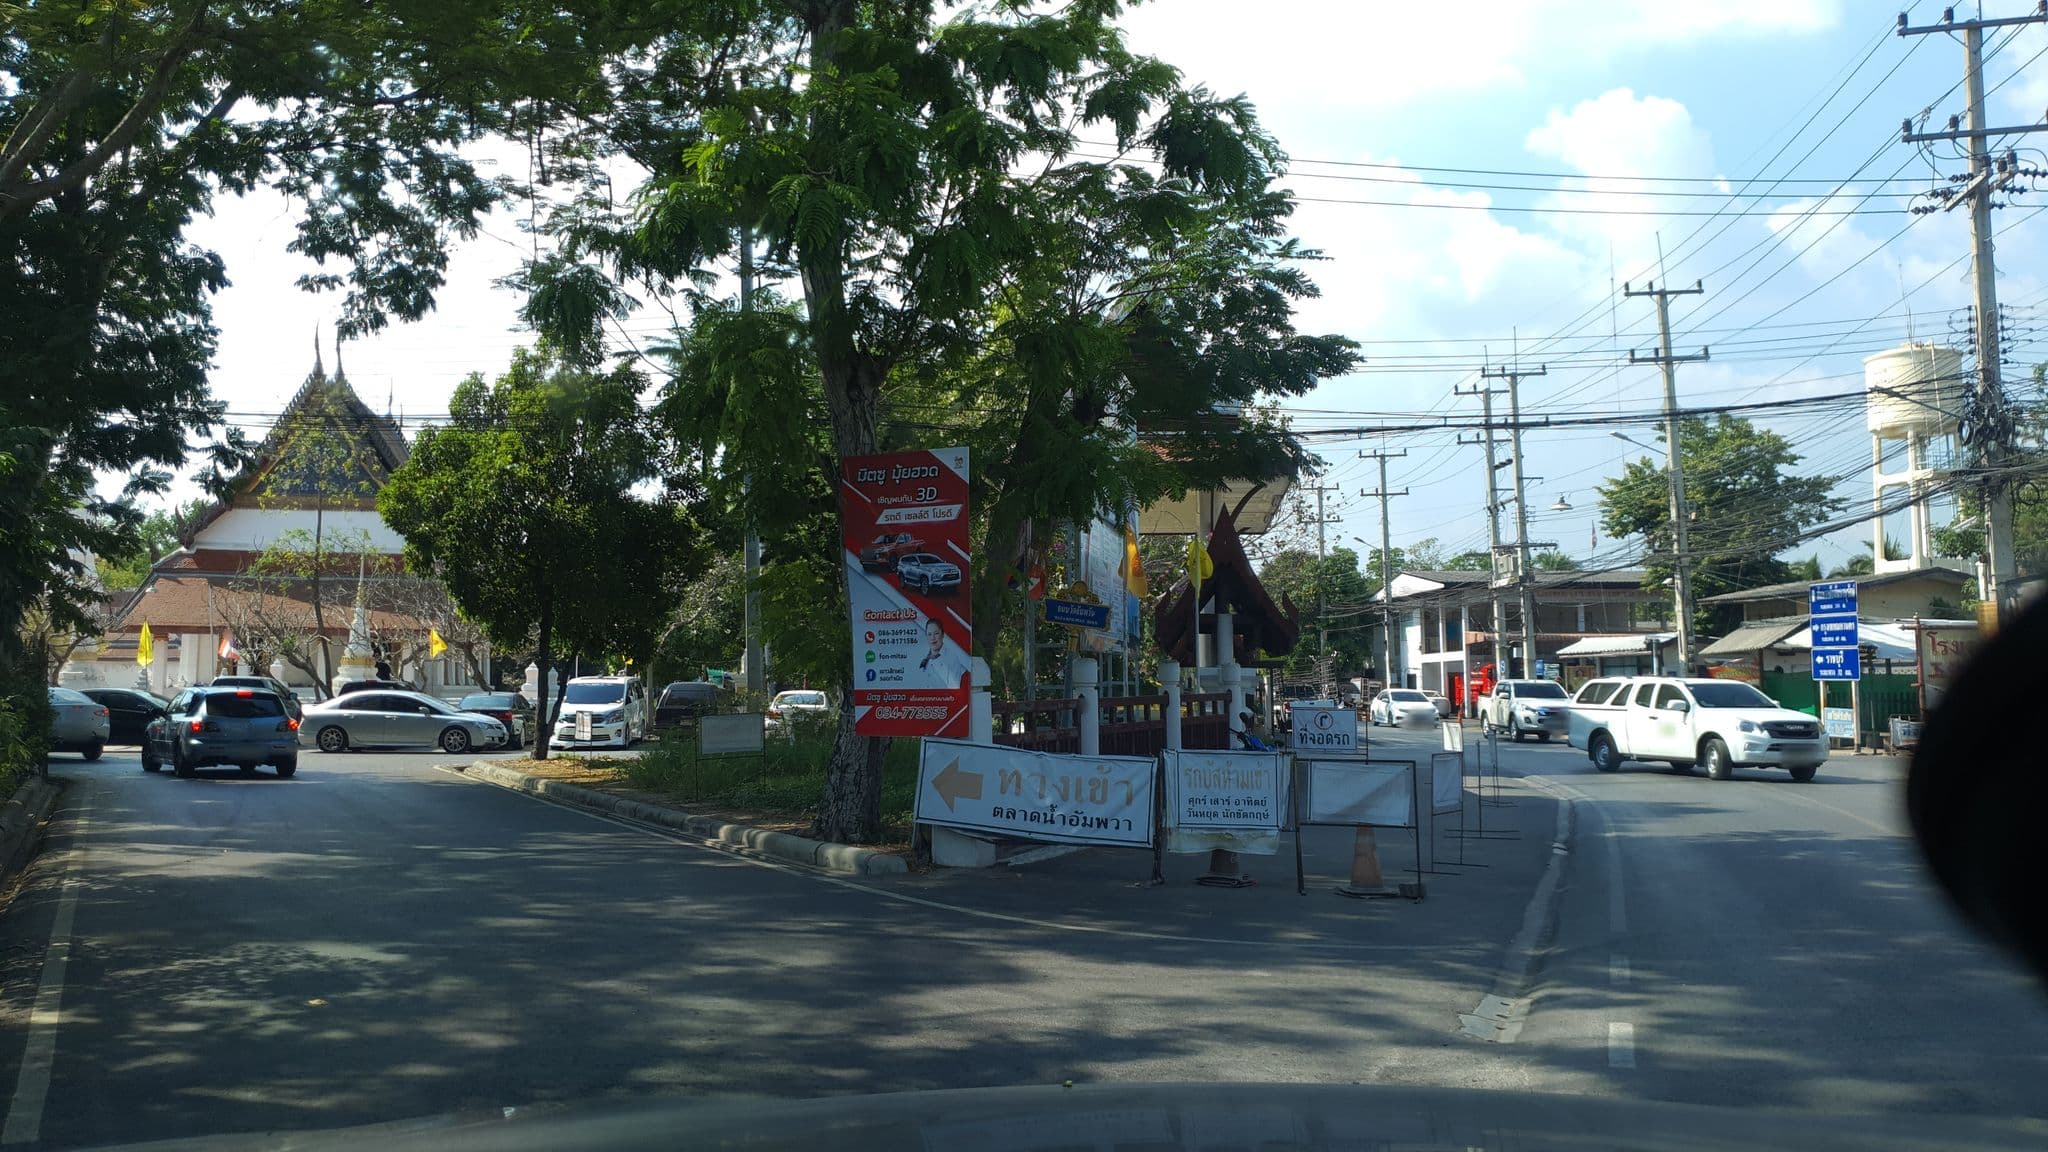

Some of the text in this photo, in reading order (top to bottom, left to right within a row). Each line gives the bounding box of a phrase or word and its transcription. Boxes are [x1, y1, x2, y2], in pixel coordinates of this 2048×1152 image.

[857, 467, 886, 485] มิตซู
[915, 487, 937, 501] 3D
[864, 608, 917, 620] Contact Us
[1826, 650, 1844, 668] ราชบุรี
[1299, 723, 1350, 745] ที่จอดรถ
[1188, 795, 1267, 807] ศุกร์ เสาร์ อาทิตย์
[992, 803, 1132, 831] ตลาดน้ำอัมพวา
[1186, 808, 1219, 820] วันหยุด
